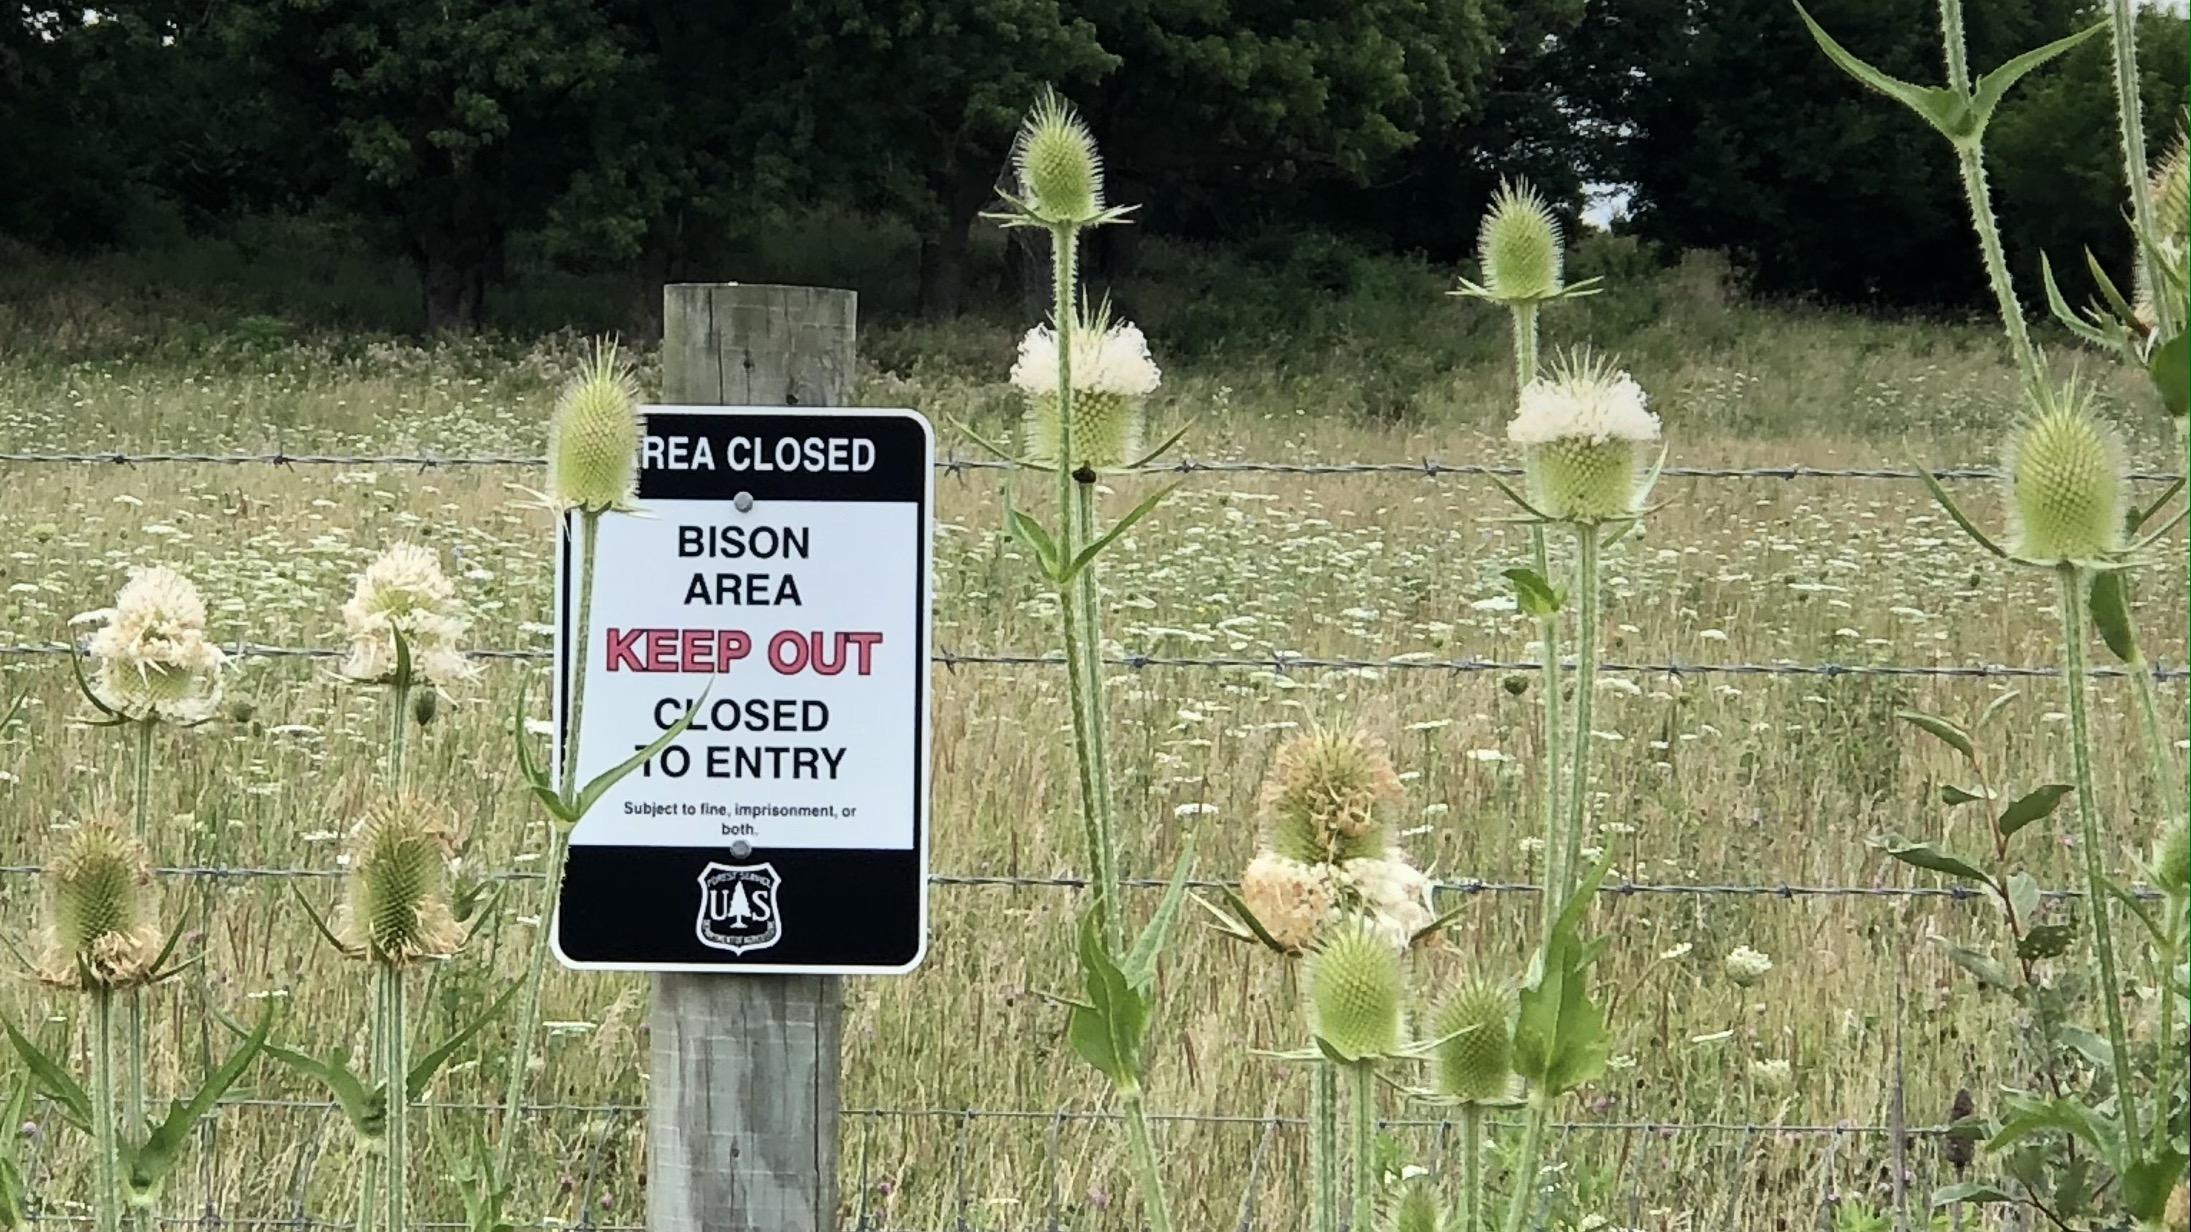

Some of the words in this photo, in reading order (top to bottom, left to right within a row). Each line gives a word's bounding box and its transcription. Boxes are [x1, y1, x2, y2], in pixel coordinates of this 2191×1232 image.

[641, 435, 716, 471] REA
[727, 436, 875, 473] CLOSED
[678, 525, 809, 560] BISON
[684, 573, 802, 606] AREA
[605, 627, 752, 675] KEEP
[767, 630, 884, 676] OUT
[654, 697, 829, 732] CLOSED
[706, 745, 847, 780] ENTRY
[623, 801, 678, 818] Subject
[681, 802, 697, 816] to
[700, 802, 732, 819] fine,
[734, 802, 838, 821] imprisonment,
[841, 806, 857, 817] or
[721, 822, 759, 837] both.
